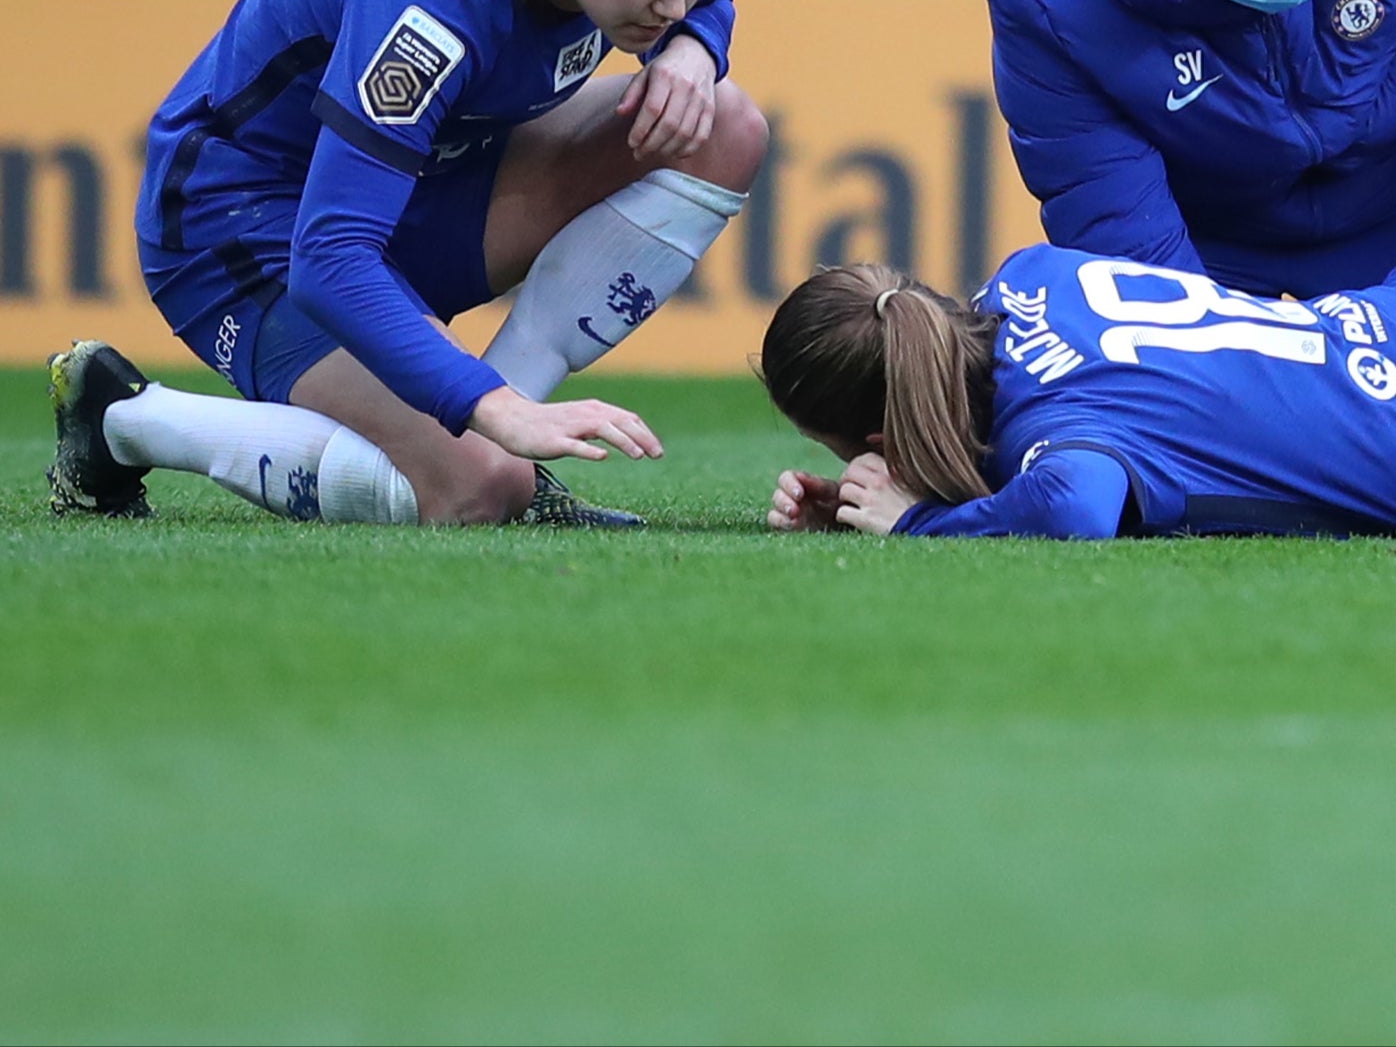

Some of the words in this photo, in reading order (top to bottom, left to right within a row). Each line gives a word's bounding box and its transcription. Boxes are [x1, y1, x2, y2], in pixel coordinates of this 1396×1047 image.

[1174, 50, 1202, 85] SV
[1077, 260, 1326, 365] 18
[215, 314, 241, 382] NGER
